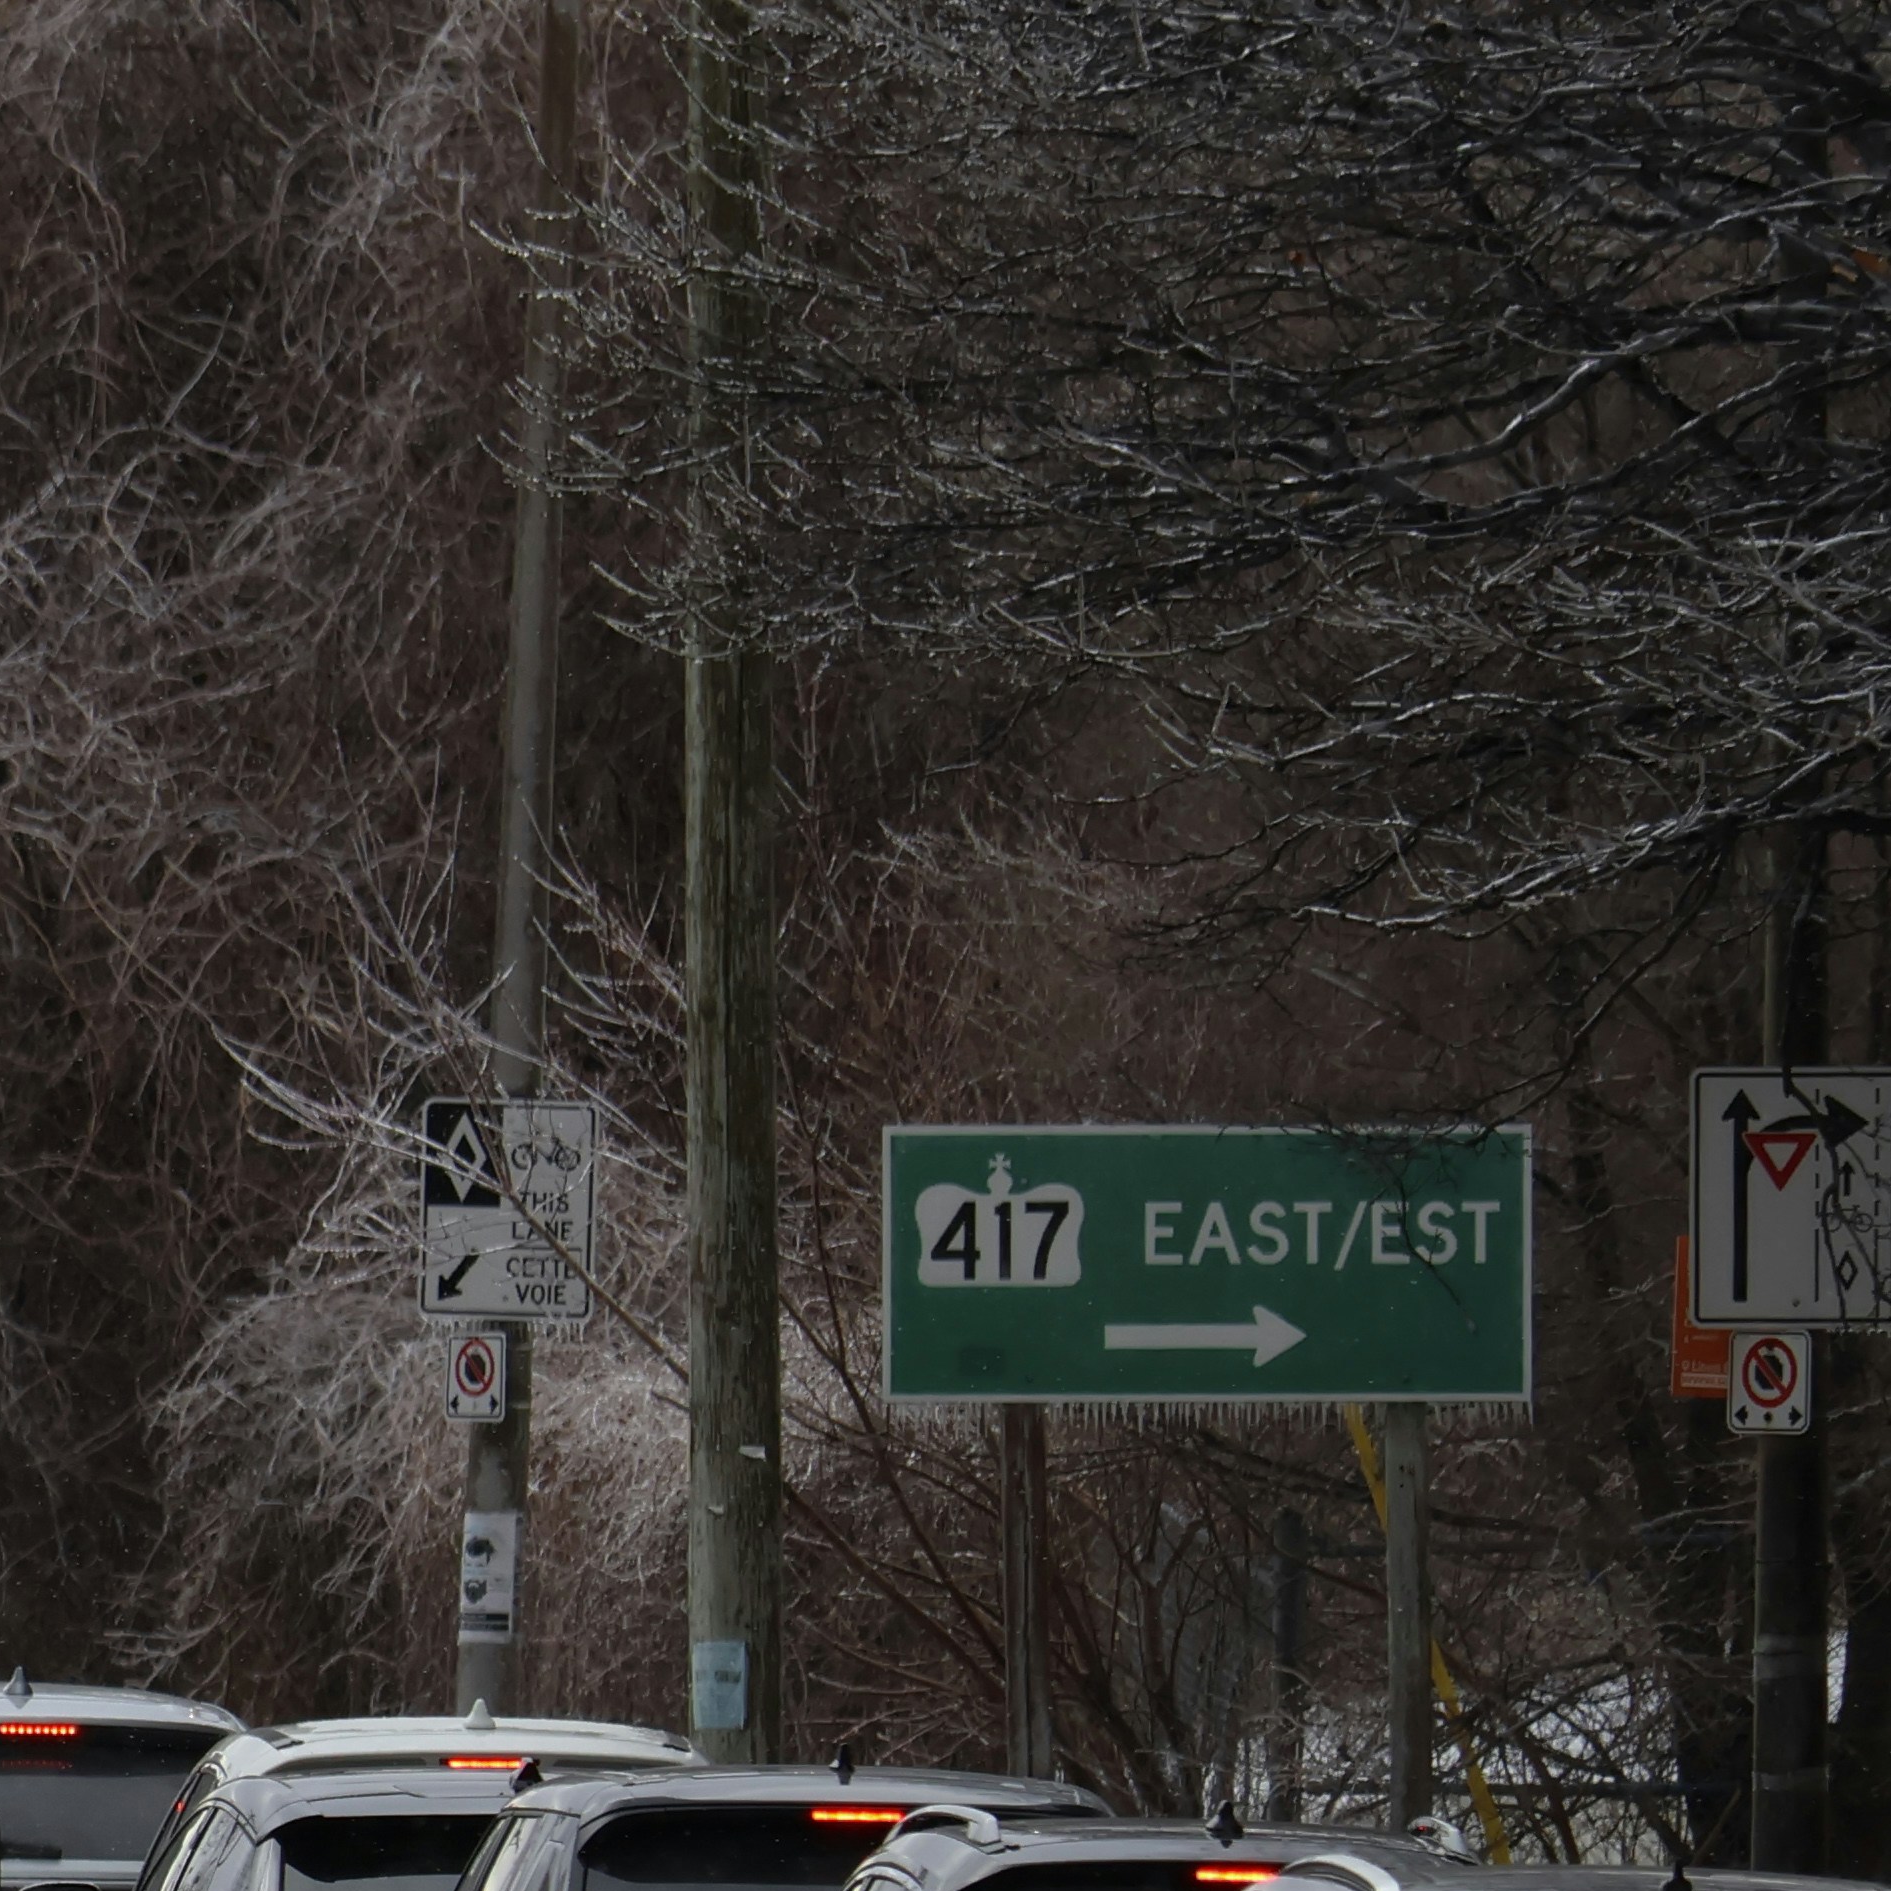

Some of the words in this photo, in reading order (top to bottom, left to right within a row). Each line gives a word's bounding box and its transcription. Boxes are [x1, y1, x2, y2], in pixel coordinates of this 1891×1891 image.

[519, 1191, 569, 1213] THIS
[512, 1221, 573, 1241] LANE
[929, 1200, 1072, 1281] 417
[1143, 1200, 1501, 1271] EAST/EST
[506, 1257, 575, 1280] CETTE
[515, 1284, 566, 1305] VOIE
